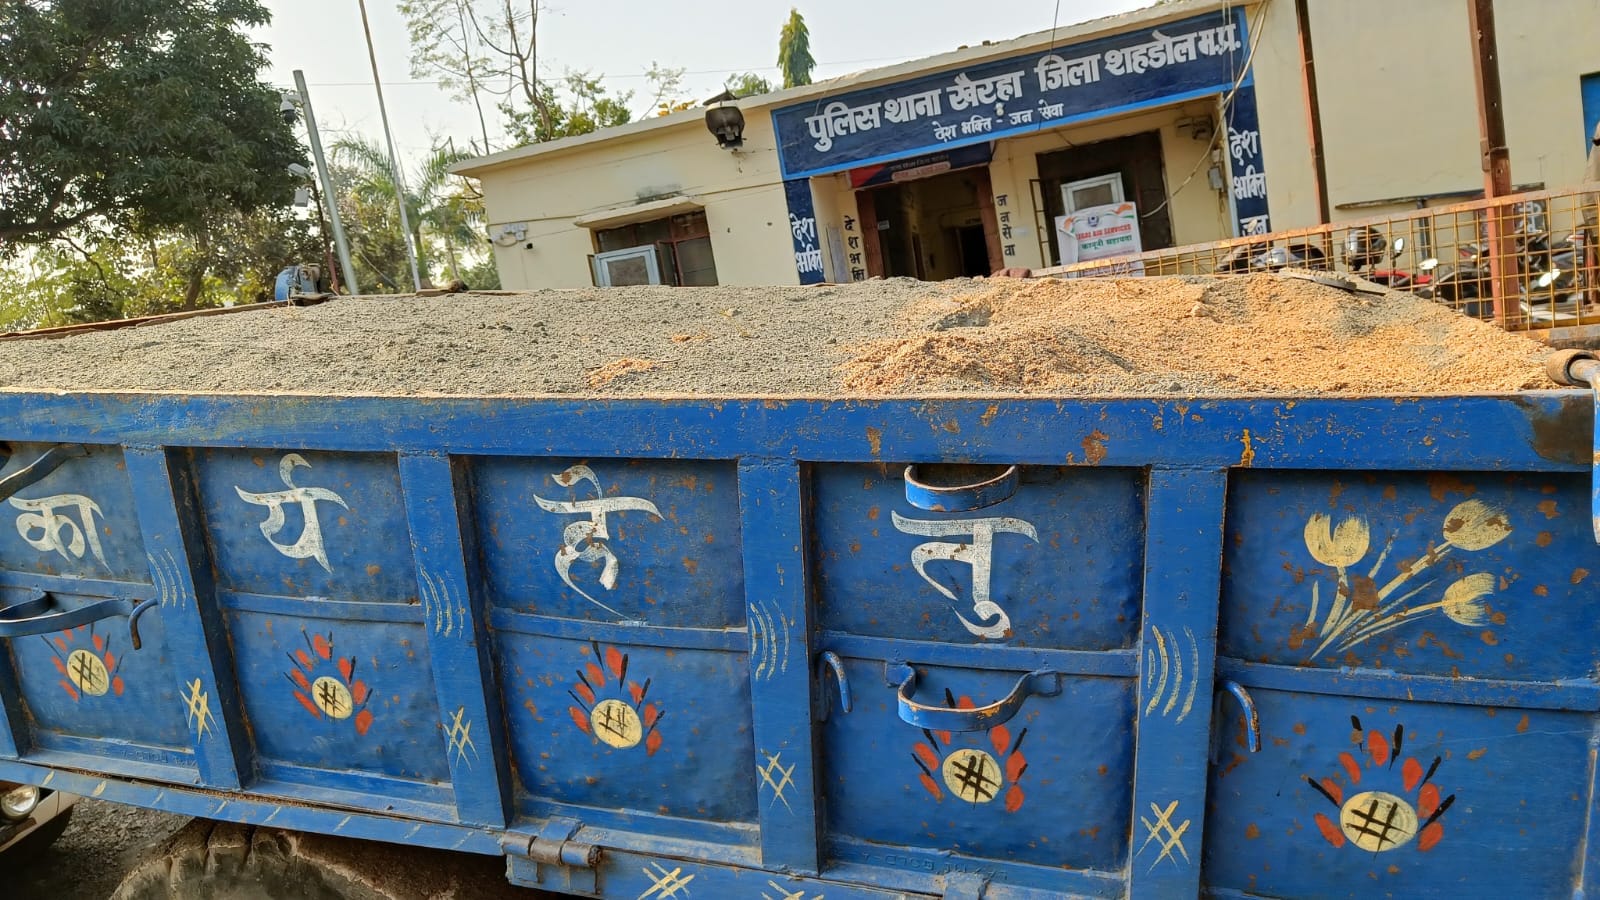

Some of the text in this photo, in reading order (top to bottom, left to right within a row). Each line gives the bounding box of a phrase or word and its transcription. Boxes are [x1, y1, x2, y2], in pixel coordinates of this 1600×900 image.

[804, 101, 883, 152] पुलिस
[884, 88, 942, 123] थाना
[946, 72, 1025, 111] खैरहा
[1034, 54, 1102, 92] जिला
[1104, 29, 1198, 76] शहडोल
[961, 114, 992, 134] भक्ति
[1008, 109, 1033, 126] जन
[1038, 99, 1064, 120] सेवा
[1228, 126, 1259, 166] देश
[1234, 164, 1266, 200] भक्ति
[790, 212, 815, 248] देश
[796, 243, 824, 273] भक्ति
